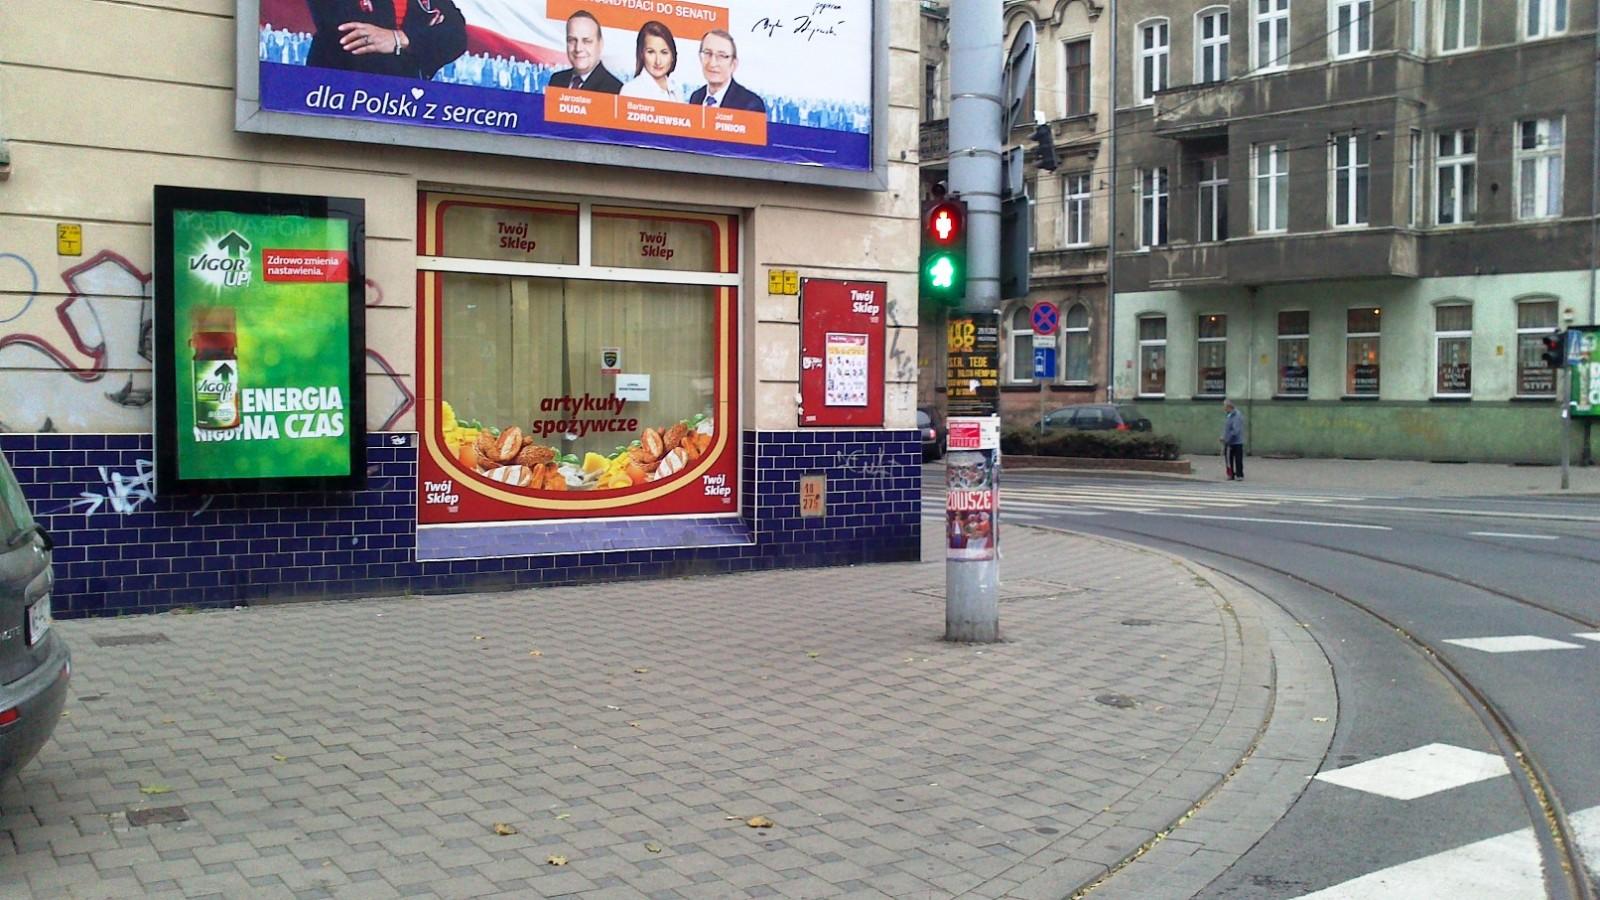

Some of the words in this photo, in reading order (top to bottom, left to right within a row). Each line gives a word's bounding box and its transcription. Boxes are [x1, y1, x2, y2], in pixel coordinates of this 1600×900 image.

[656, 3, 673, 15] DO
[675, 7, 717, 22] SENATU
[305, 85, 344, 110] dla
[352, 88, 419, 117] Polski
[422, 103, 436, 119] z
[442, 105, 518, 128] sercem
[559, 104, 587, 116] DUDA
[627, 112, 692, 128] ZDROJEWSKA
[497, 222, 529, 239] Twój
[499, 236, 536, 253] Sklep
[639, 231, 668, 247] Twój
[267, 255, 303, 266] Zdrowo
[303, 257, 339, 266] zmienia
[641, 244, 674, 261] Sklep
[267, 265, 324, 276] nastawienia.
[850, 290, 874, 303] Twój
[852, 302, 880, 316] Sklep
[242, 386, 343, 413] ENERGIA
[540, 393, 627, 415] artykuły
[243, 415, 280, 441] NA
[284, 412, 345, 439] CZAS
[532, 415, 639, 438] spożywcze
[424, 480, 452, 494] Twój
[703, 474, 726, 488] Twój
[426, 492, 459, 506] Sklep
[704, 484, 731, 499] Sklep
